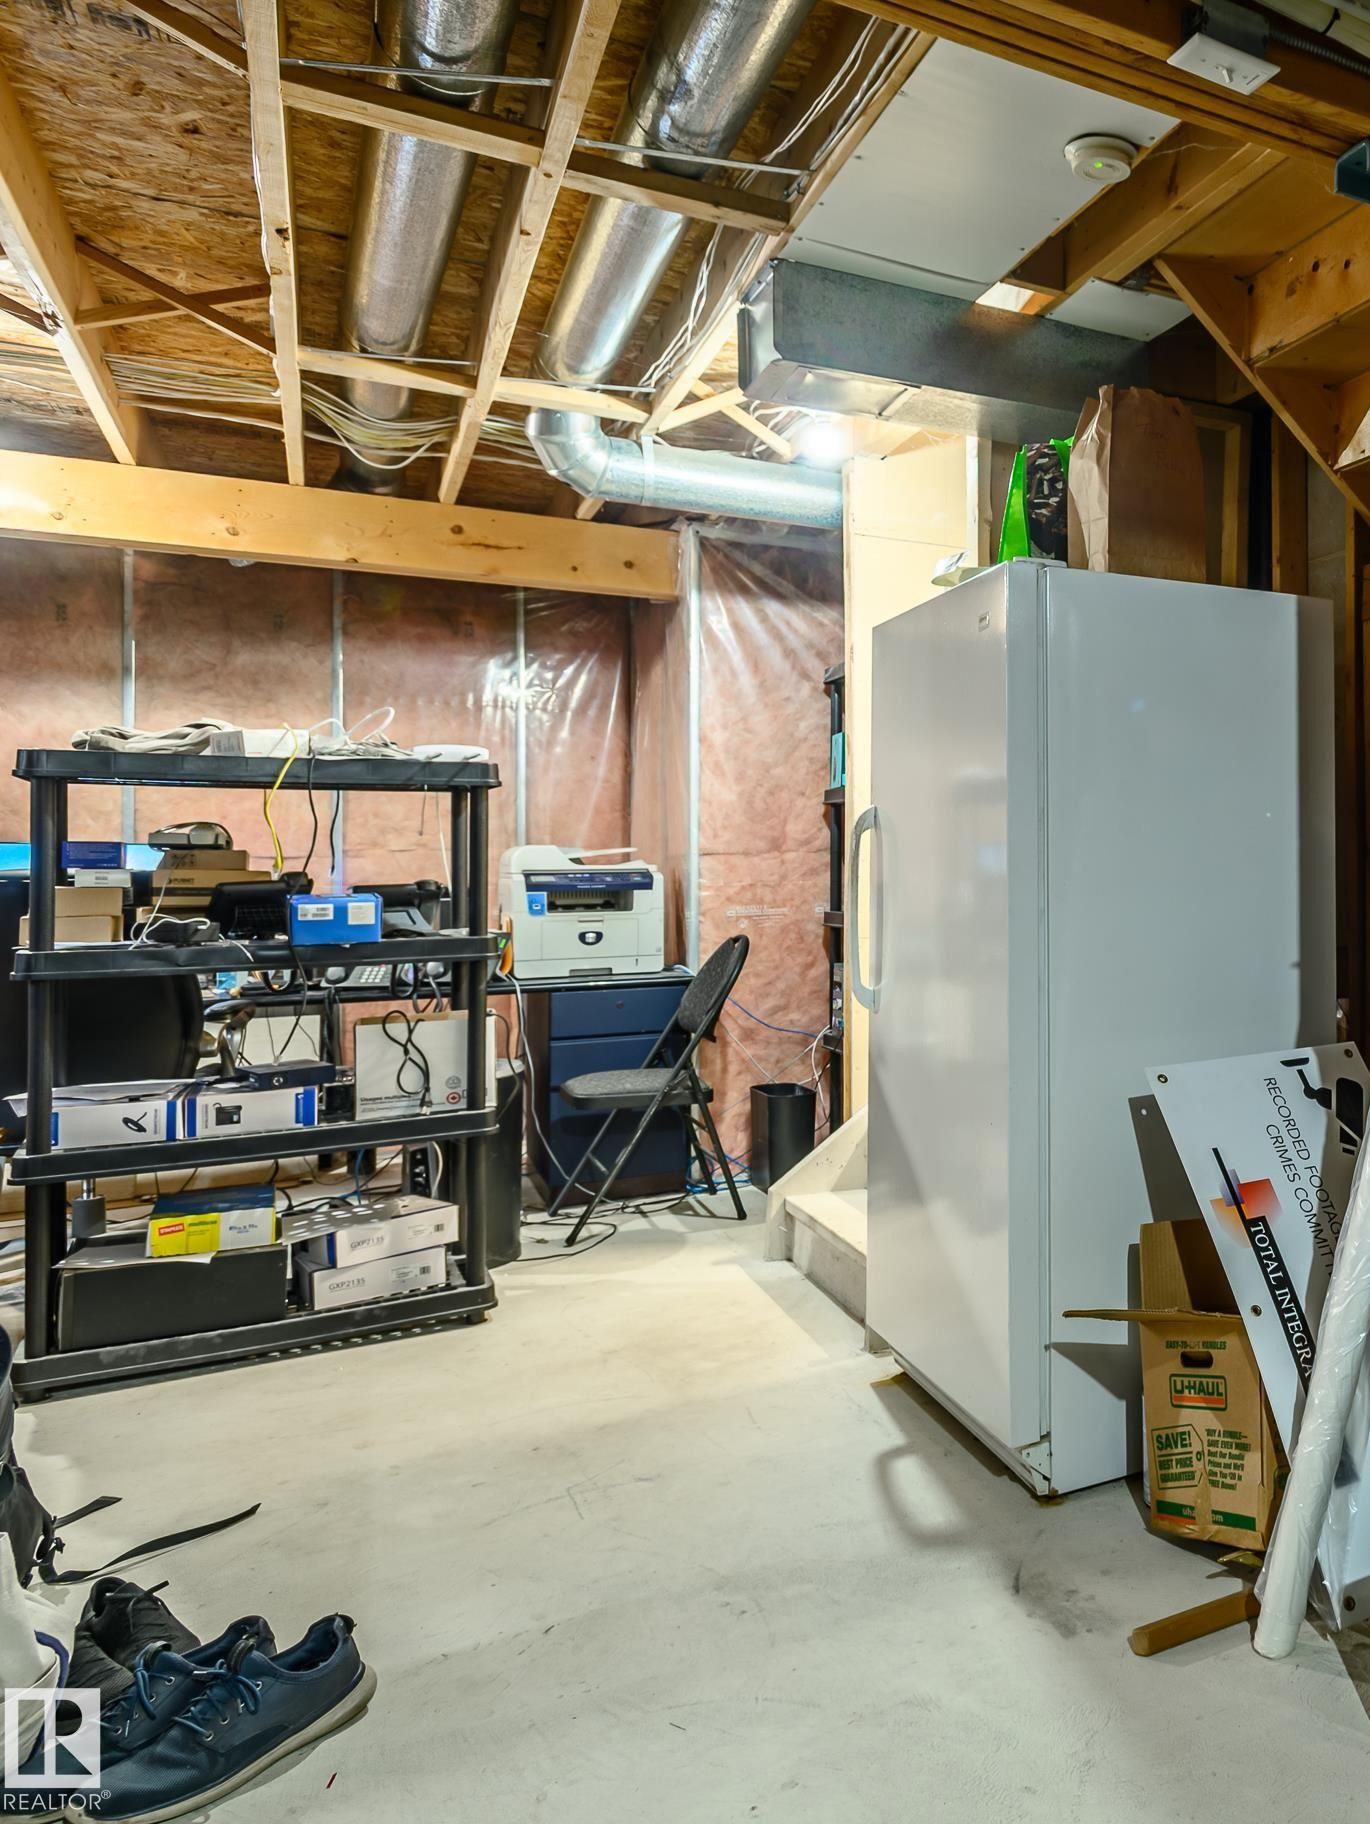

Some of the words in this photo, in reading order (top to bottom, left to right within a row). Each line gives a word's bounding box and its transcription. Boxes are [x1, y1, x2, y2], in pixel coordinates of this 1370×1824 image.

[1264, 1077, 1310, 1161] RECORDED
[1304, 1165, 1342, 1243] FOOTAG
[1266, 1124, 1300, 1183] CRIMES
[1250, 1221, 1279, 1285] TOTAL
[1173, 1379, 1224, 1396] U-HAUL
[1155, 1430, 1192, 1451] SAVE!
[1207, 1439, 1220, 1448] SAVE
[1221, 1441, 1234, 1450] EVEN
[1158, 1459, 1174, 1471] BEST
[1175, 1457, 1194, 1469] PRICE
[1208, 1459, 1222, 1469] Prices
